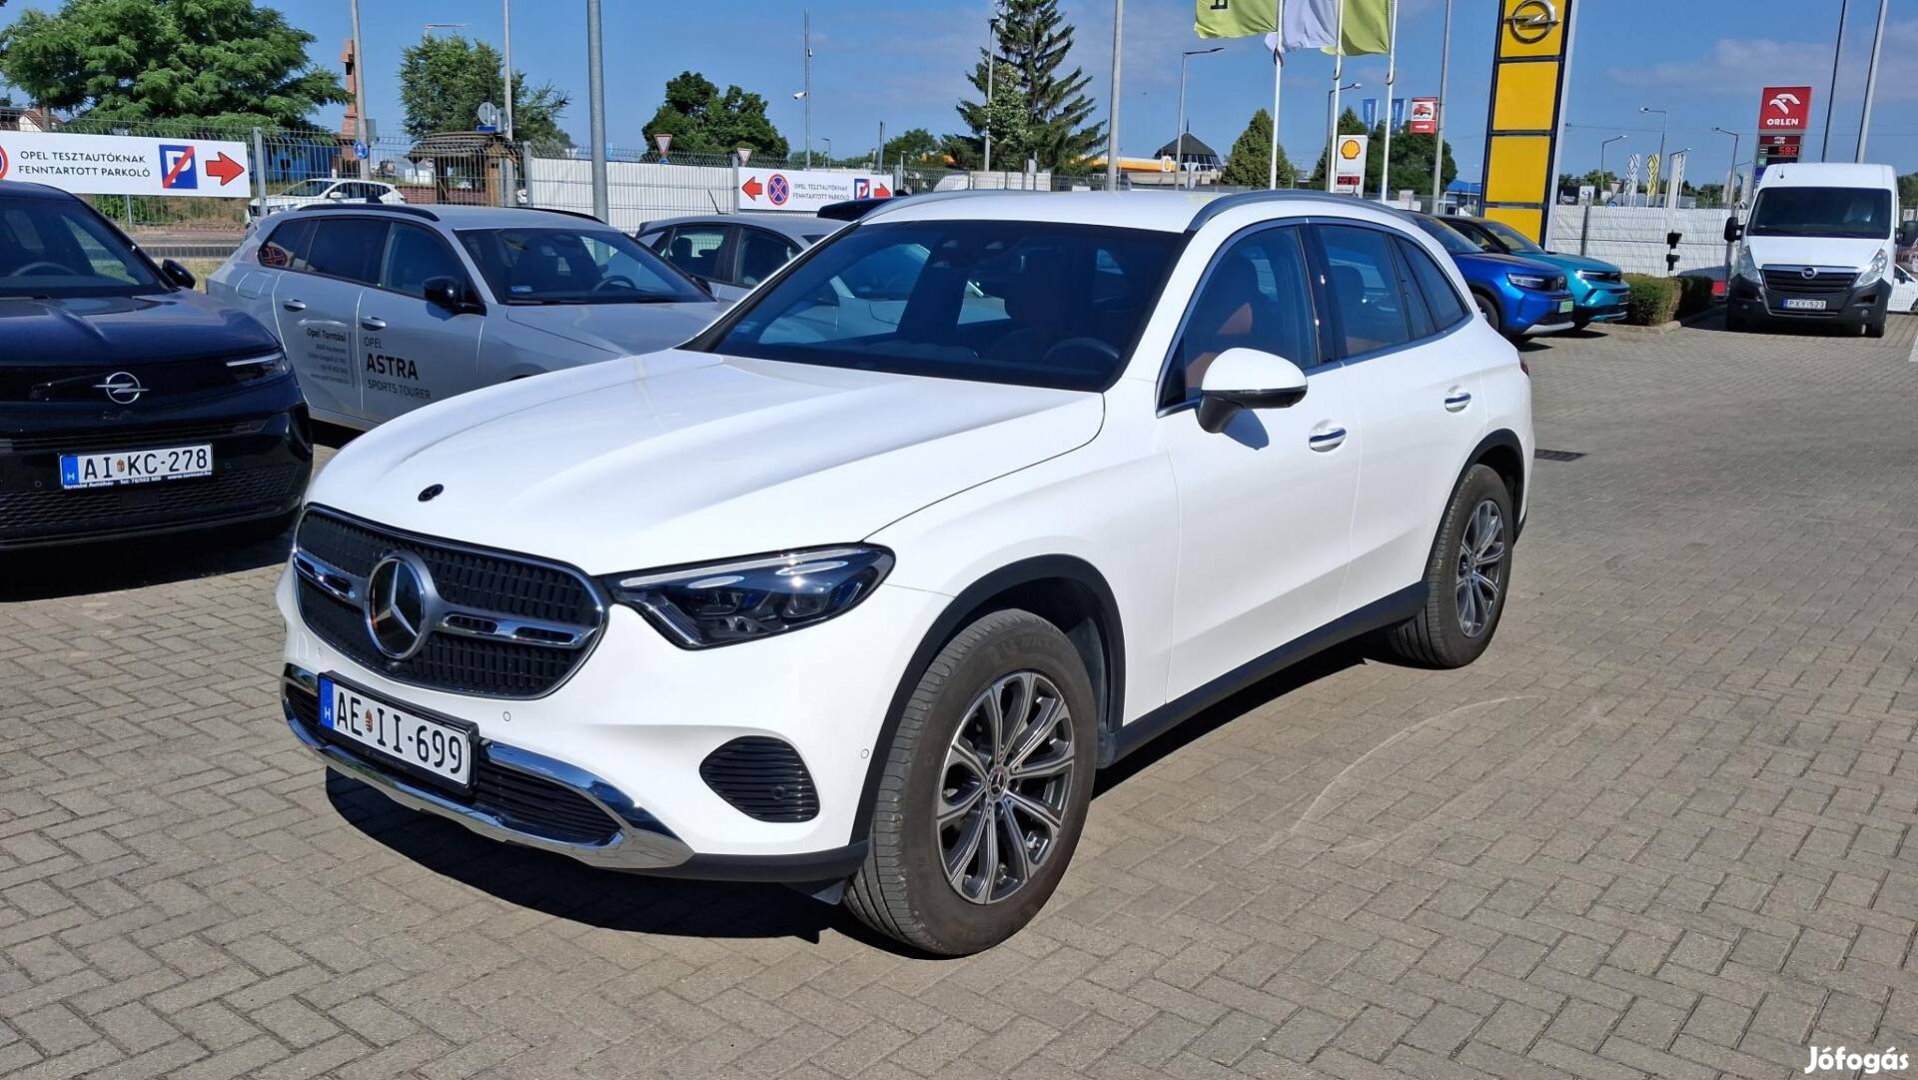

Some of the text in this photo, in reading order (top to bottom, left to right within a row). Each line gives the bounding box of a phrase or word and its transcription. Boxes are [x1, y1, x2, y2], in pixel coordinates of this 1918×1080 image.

[1766, 118, 1799, 126] ORLEN
[20, 150, 146, 164] OPEL TESZTAUTÓKNAK
[18, 165, 151, 178] FENNTARTOTT PARKOLÓ
[364, 336, 384, 349] OPEL
[366, 353, 419, 380] ASTRA
[367, 379, 431, 399] SPORTS TOURER
